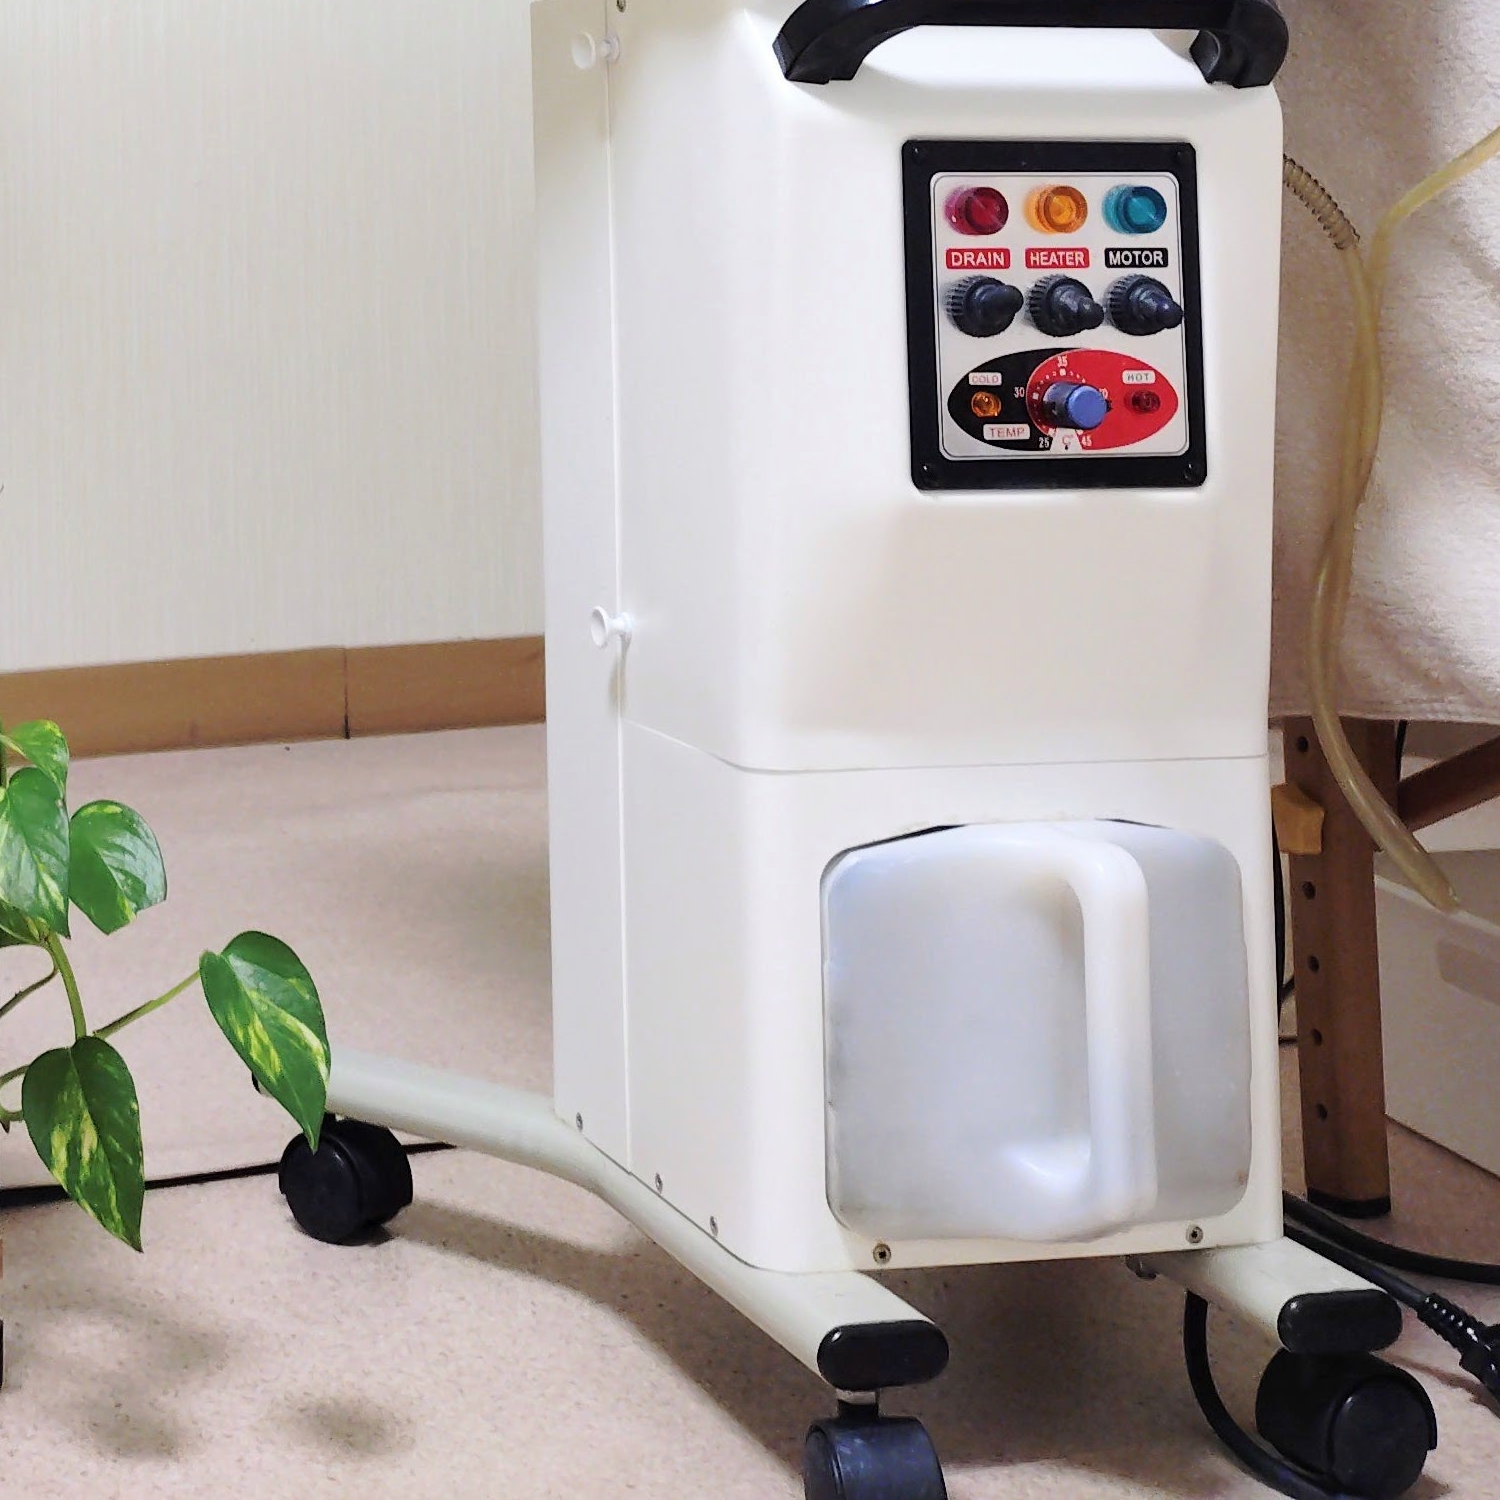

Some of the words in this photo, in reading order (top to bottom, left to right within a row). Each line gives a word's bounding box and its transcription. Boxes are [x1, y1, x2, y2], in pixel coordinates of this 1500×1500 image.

[951, 251, 1005, 267] DRAIN
[1030, 251, 1086, 267] HEATER
[1108, 250, 1164, 266] MOTOR
[1057, 355, 1068, 368] 35
[971, 372, 1000, 384] COLD
[1127, 372, 1150, 382] HOT
[1014, 386, 1025, 399] 30
[988, 427, 1026, 440] TEMP
[1038, 436, 1050, 449] 25
[1081, 435, 1093, 447] 45
